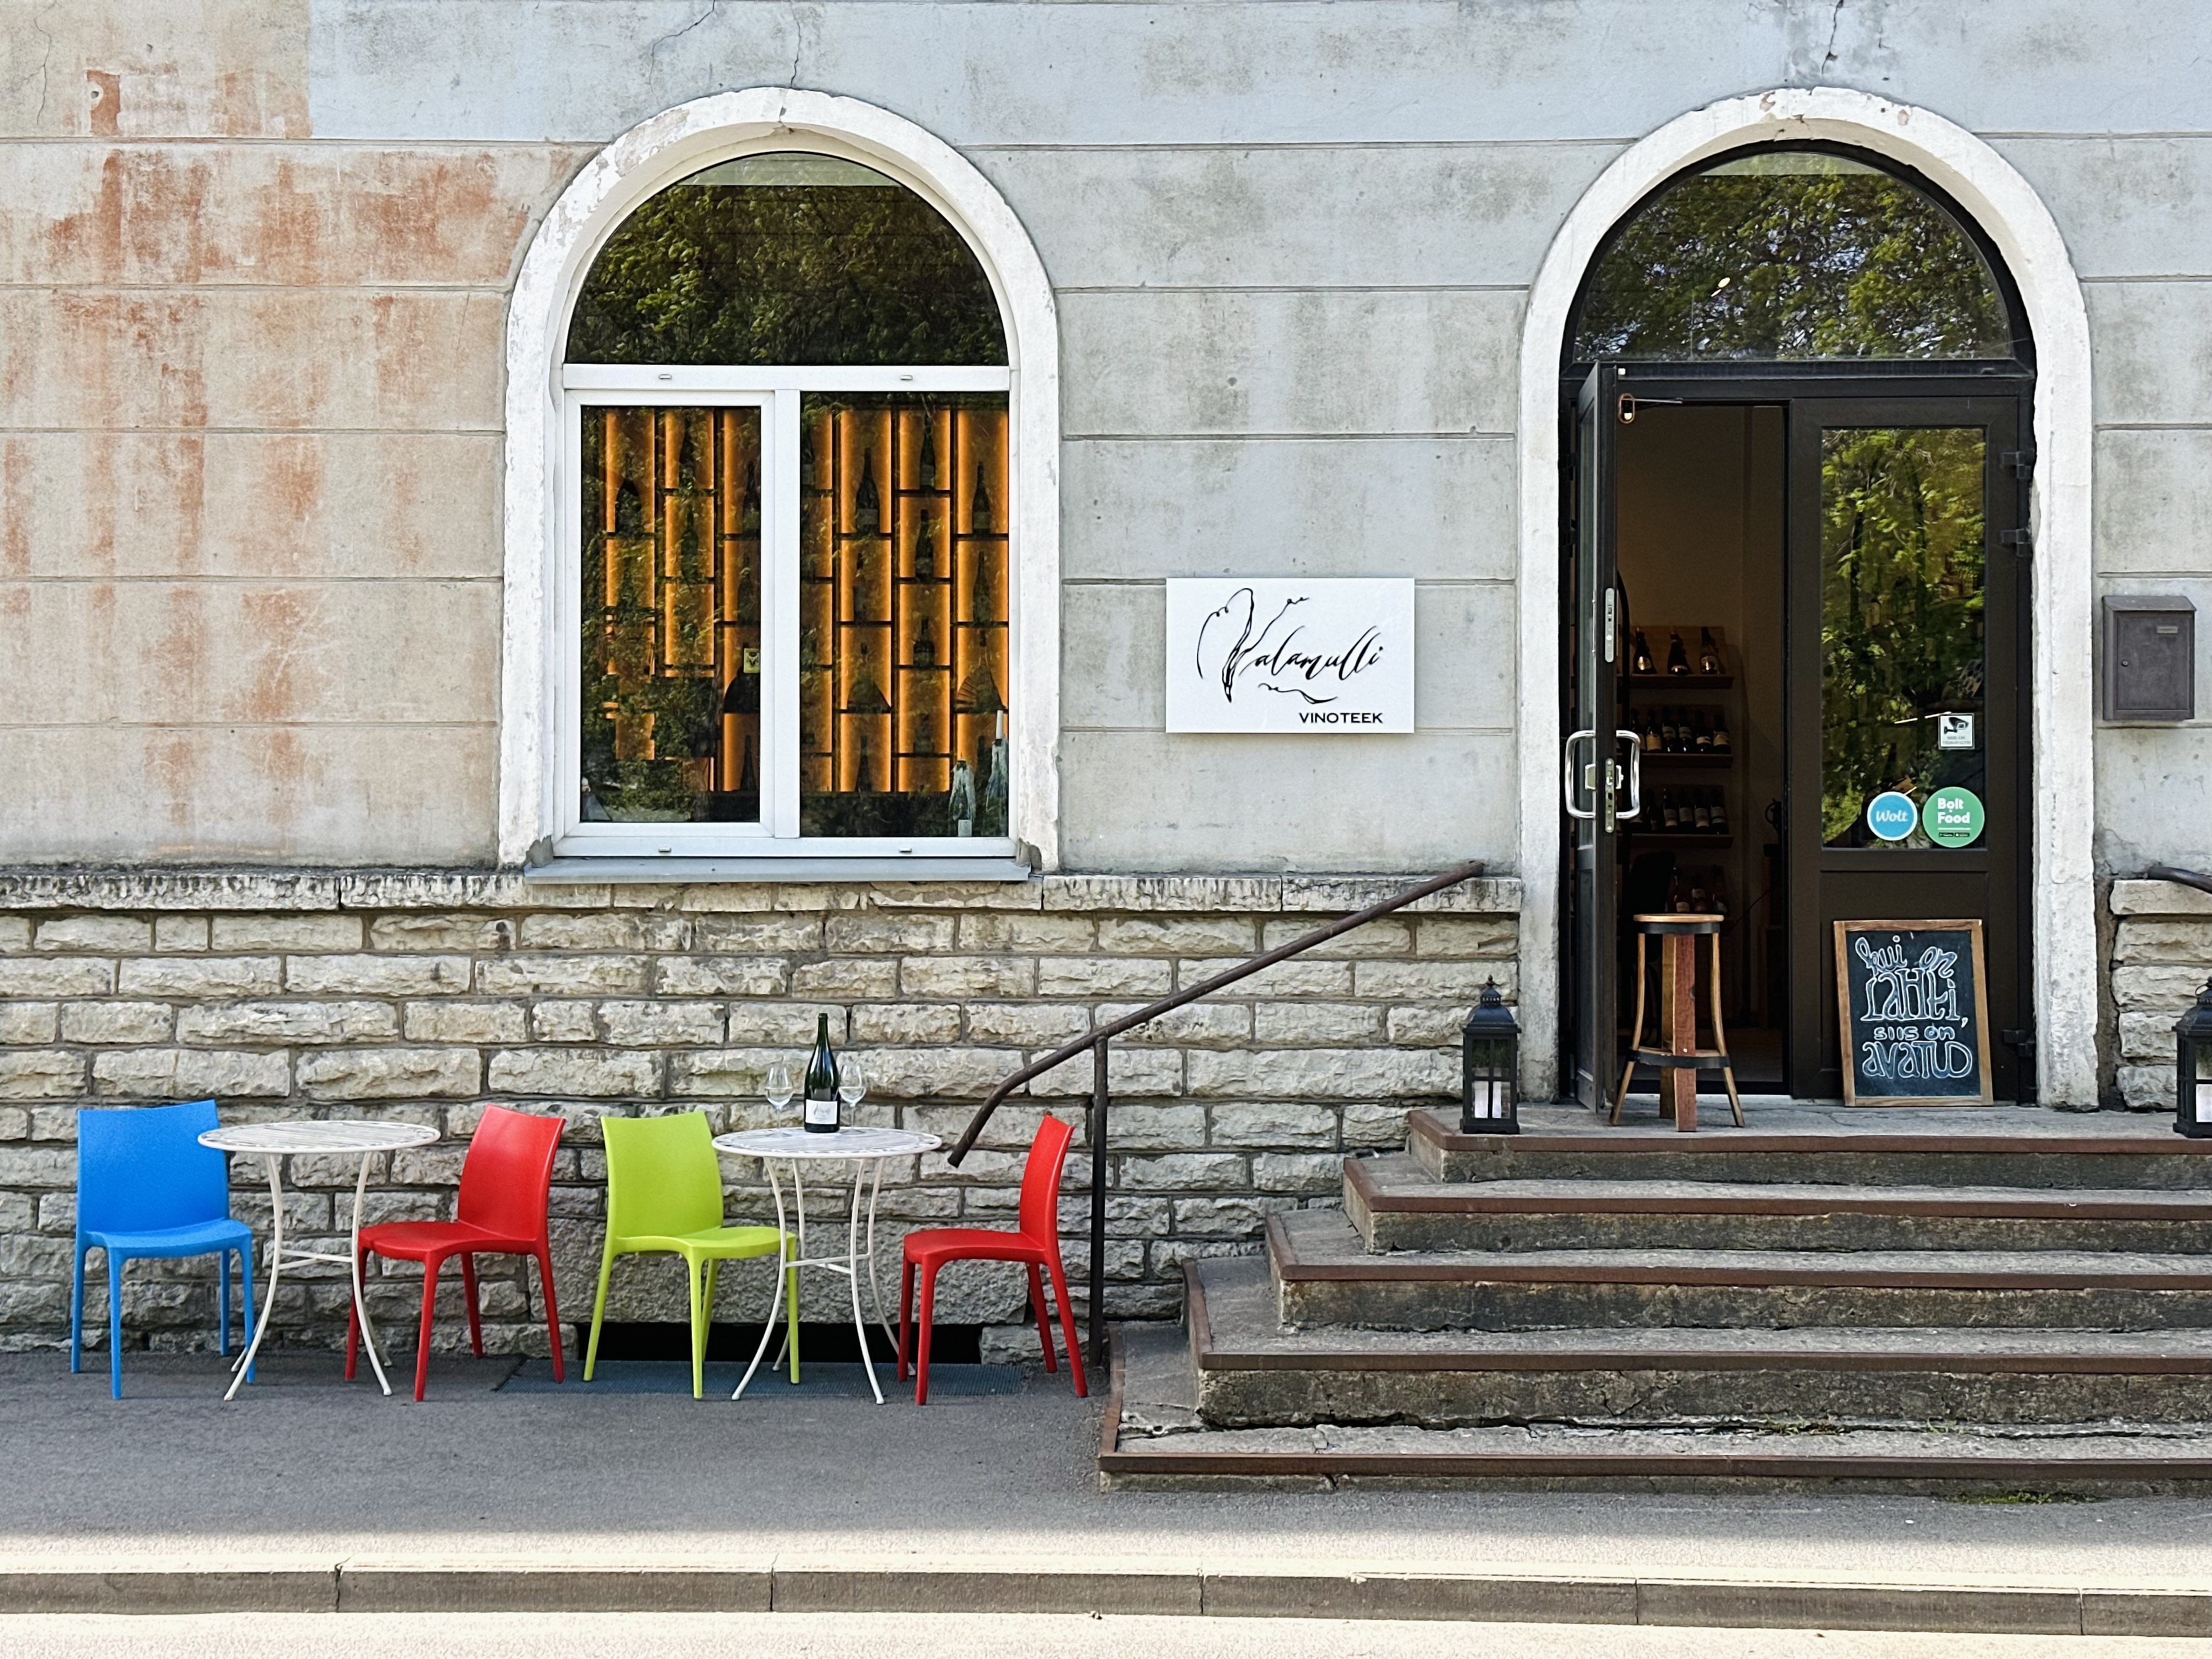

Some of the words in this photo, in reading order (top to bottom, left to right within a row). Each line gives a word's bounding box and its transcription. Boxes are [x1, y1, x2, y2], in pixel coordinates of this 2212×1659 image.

[1197, 588, 1383, 704] Kalamulli
[1299, 712, 1383, 724] VINOTEEK
[1937, 797, 1965, 810] Bolt
[1876, 809, 1909, 822] Wolt
[1937, 812, 1971, 824] Food
[1919, 946, 1958, 979] on
[1924, 1025, 1956, 1041] on
